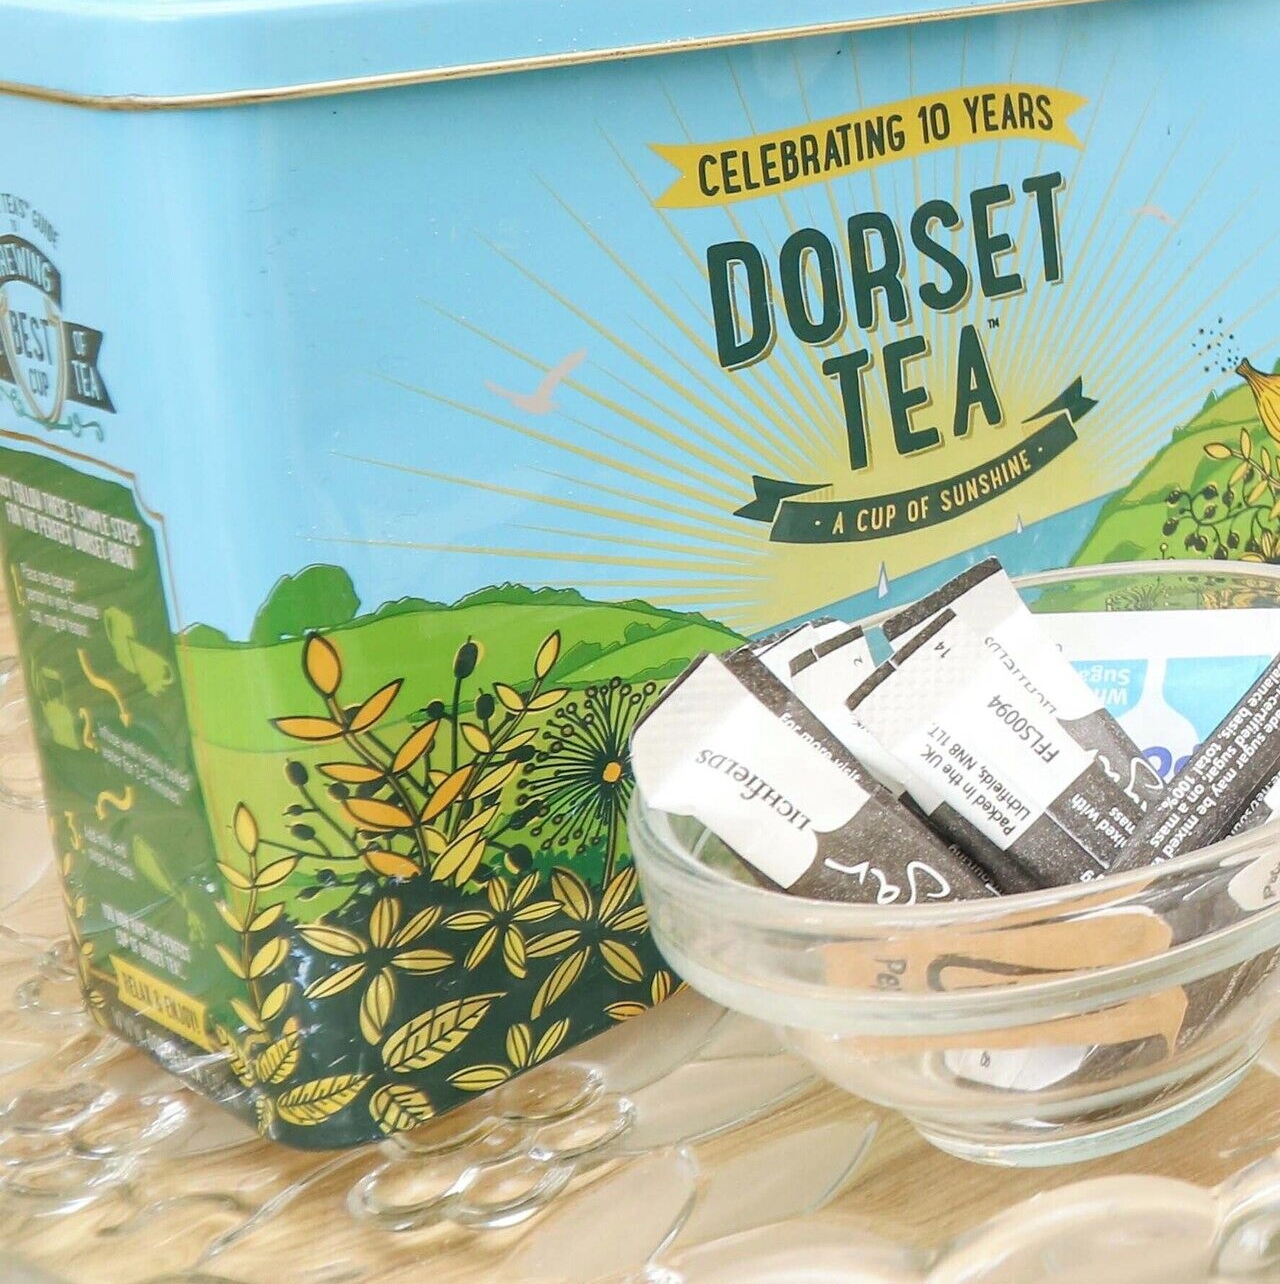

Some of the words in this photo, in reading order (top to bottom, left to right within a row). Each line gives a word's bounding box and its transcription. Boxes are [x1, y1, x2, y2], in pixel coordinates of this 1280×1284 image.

[698, 115, 906, 198] CELEBRATING
[918, 102, 952, 144] 10
[964, 92, 1055, 134] YEARS
[706, 171, 1066, 371] DORSET
[8, 309, 53, 366] BEST
[71, 360, 102, 401] TEA
[821, 323, 1004, 472] TEA
[832, 512, 845, 535] A
[857, 505, 896, 532] CUP
[907, 498, 930, 523] OF
[940, 449, 1032, 513] SUNSHINE
[933, 640, 952, 659] 14
[986, 693, 1061, 765] FFLS0094
[1216, 705, 1254, 741] basis,
[947, 742, 979, 772] NN8
[1193, 741, 1222, 776] total
[1201, 744, 1238, 783] sugar,
[1235, 733, 1267, 770] sugar
[942, 764, 964, 786] the
[962, 781, 976, 800] in
[977, 764, 1032, 822] Lichfields,
[1210, 766, 1239, 799] may
[1068, 793, 1100, 824] with
[1178, 804, 1190, 815] a
[1186, 784, 1206, 804] on
[1195, 795, 1218, 816] be
[972, 792, 1017, 836] Packed
[1149, 813, 1180, 848] mass
[1162, 817, 1200, 859] mixed
